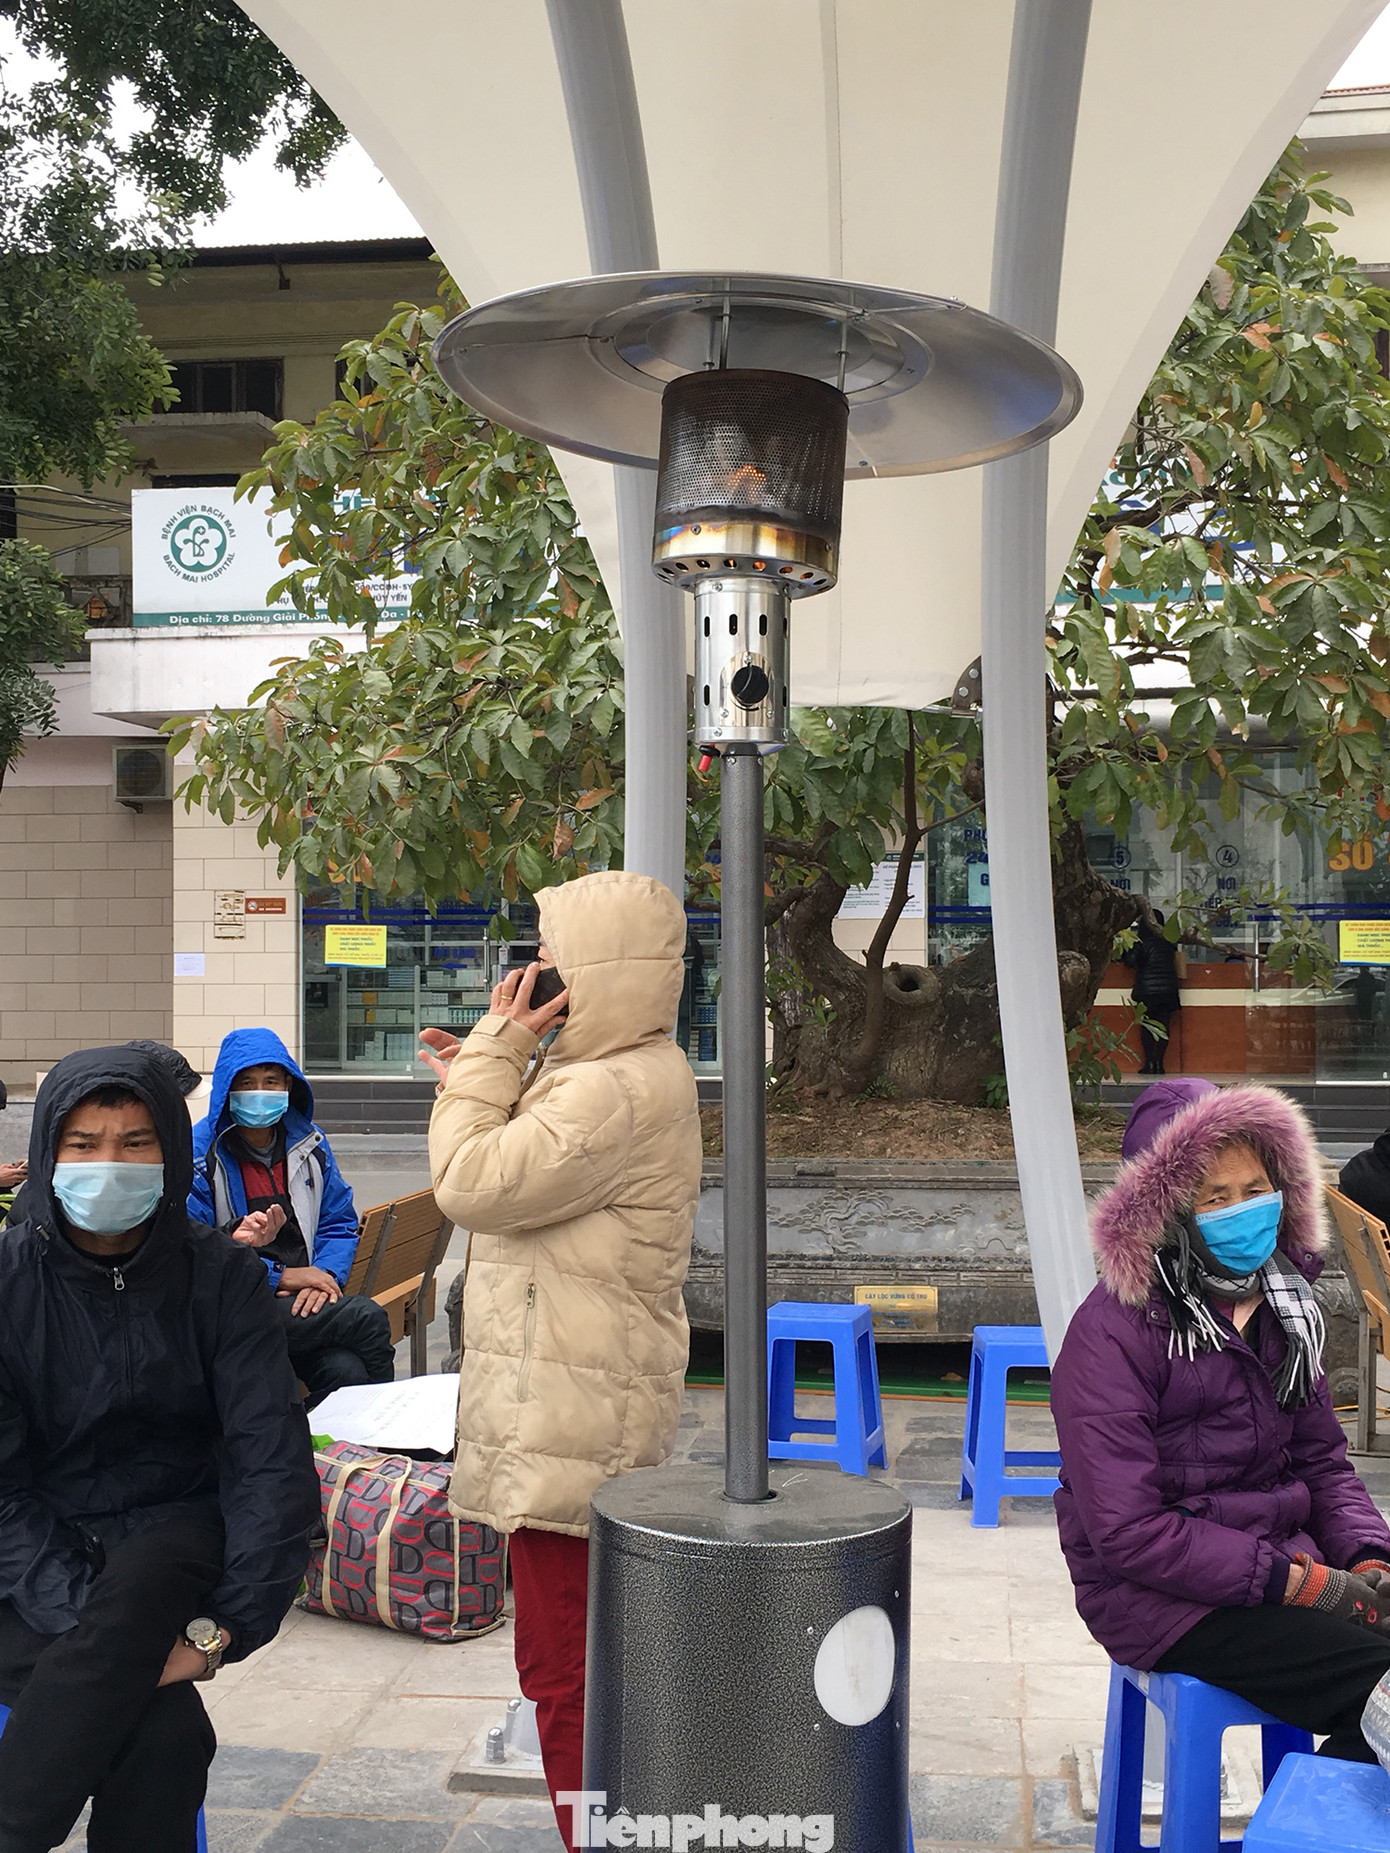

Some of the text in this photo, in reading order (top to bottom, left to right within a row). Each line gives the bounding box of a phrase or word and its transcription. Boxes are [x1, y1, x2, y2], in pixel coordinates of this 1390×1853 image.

[161, 504, 237, 540] BỆNH VIỆN BẠCH MAI
[163, 552, 236, 584] BACH MAI HOSPITAL
[169, 615, 190, 625] Địa
[192, 614, 212, 623] chỉ:
[215, 614, 229, 623] 78
[877, 1292, 889, 1300] LỘC
